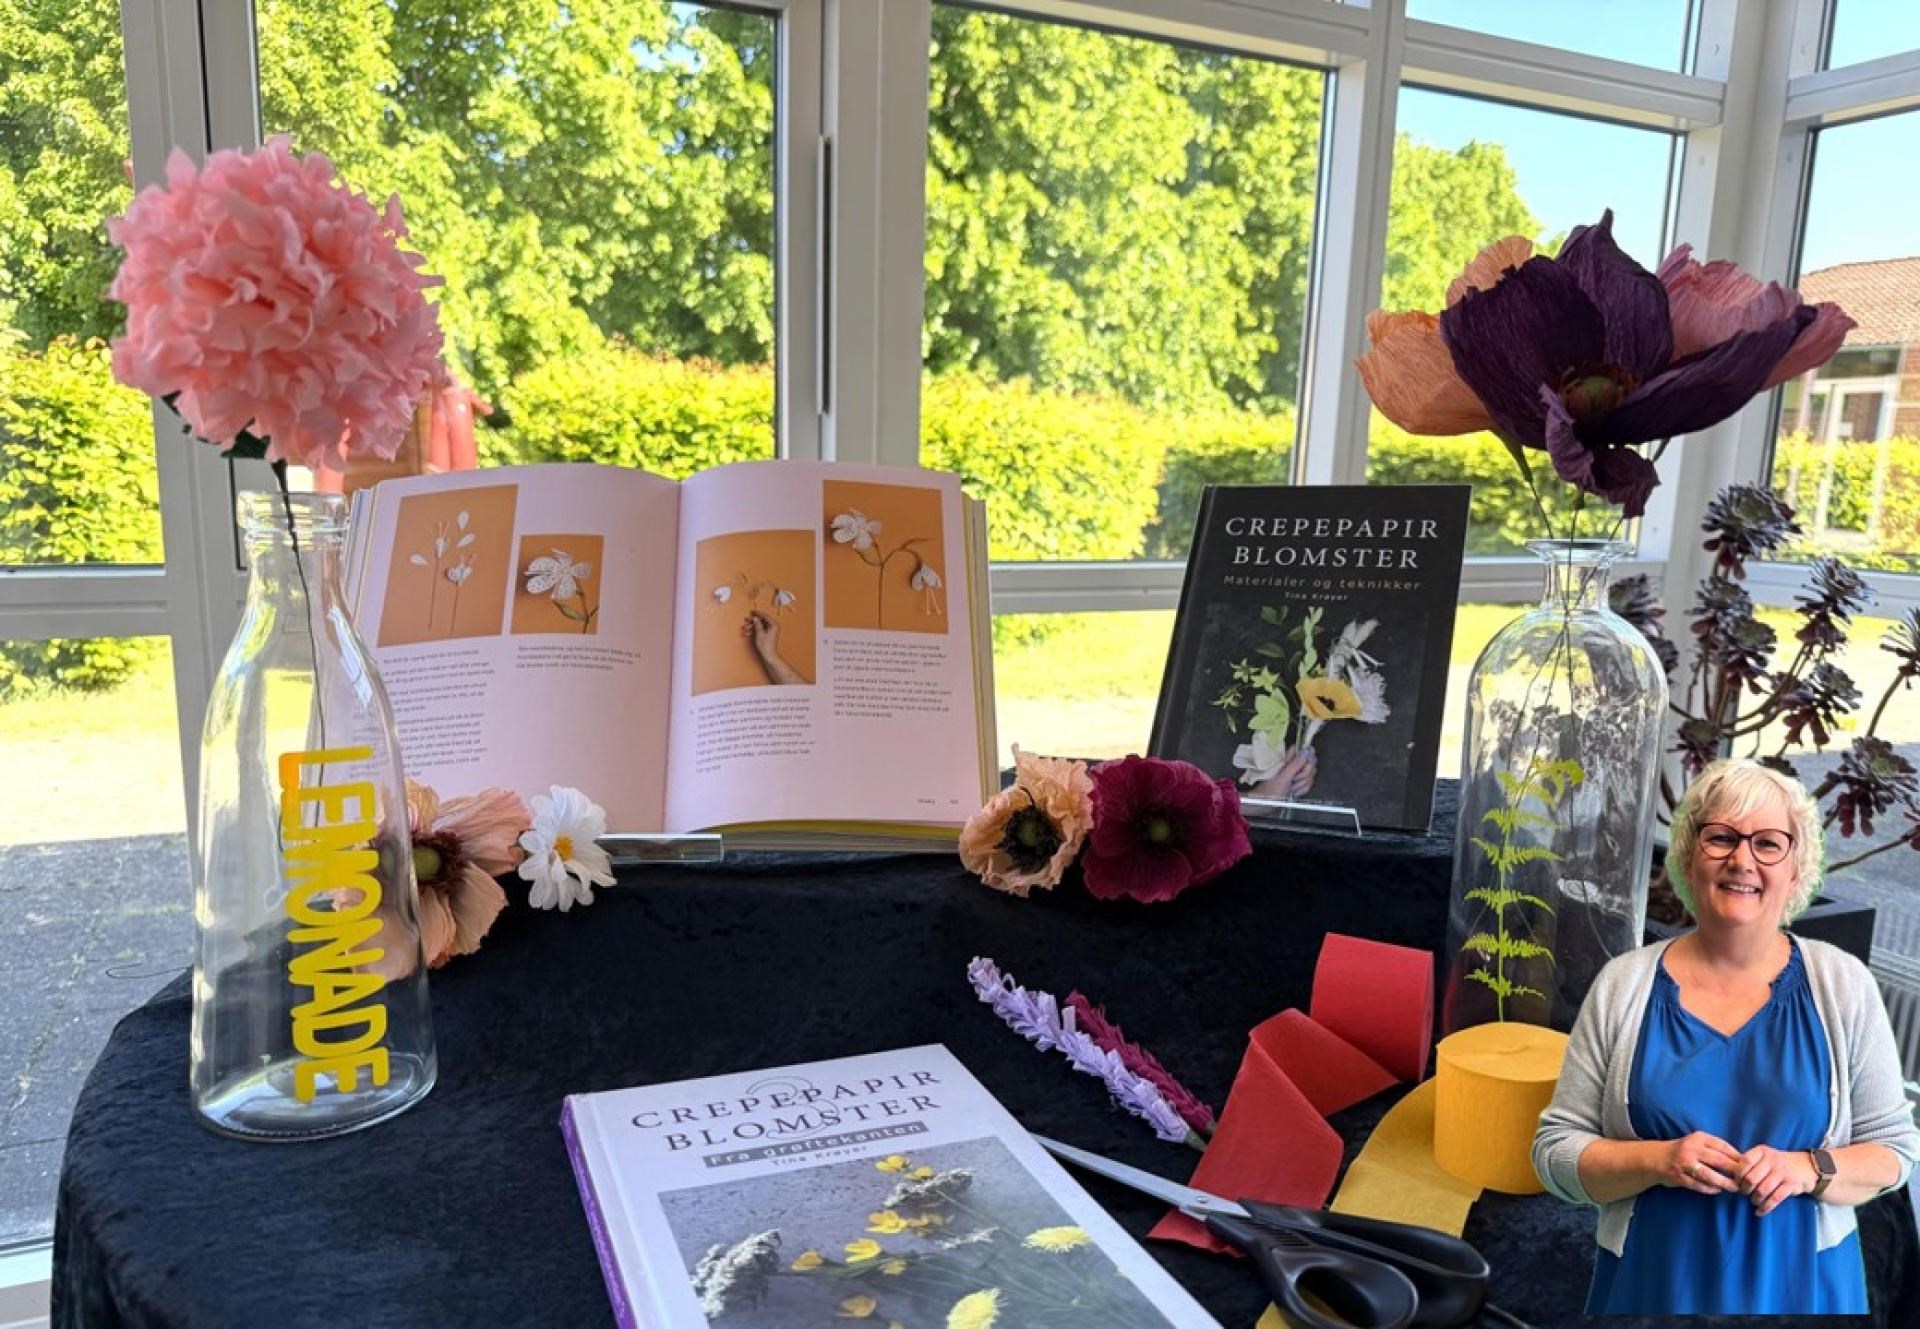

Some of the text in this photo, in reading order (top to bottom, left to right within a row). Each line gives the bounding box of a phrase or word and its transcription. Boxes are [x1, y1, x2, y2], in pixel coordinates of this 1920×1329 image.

[1224, 516, 1439, 539] CREPEPAPIR
[1233, 546, 1419, 569] BLOMSTER
[1223, 575, 1422, 591] Materialer og teknikker
[278, 746, 390, 1103] LEMONADE
[631, 1070, 942, 1129] CREPEPAPIR
[664, 1095, 943, 1152] BLOMSTER
[710, 1151, 751, 1166] Fra
